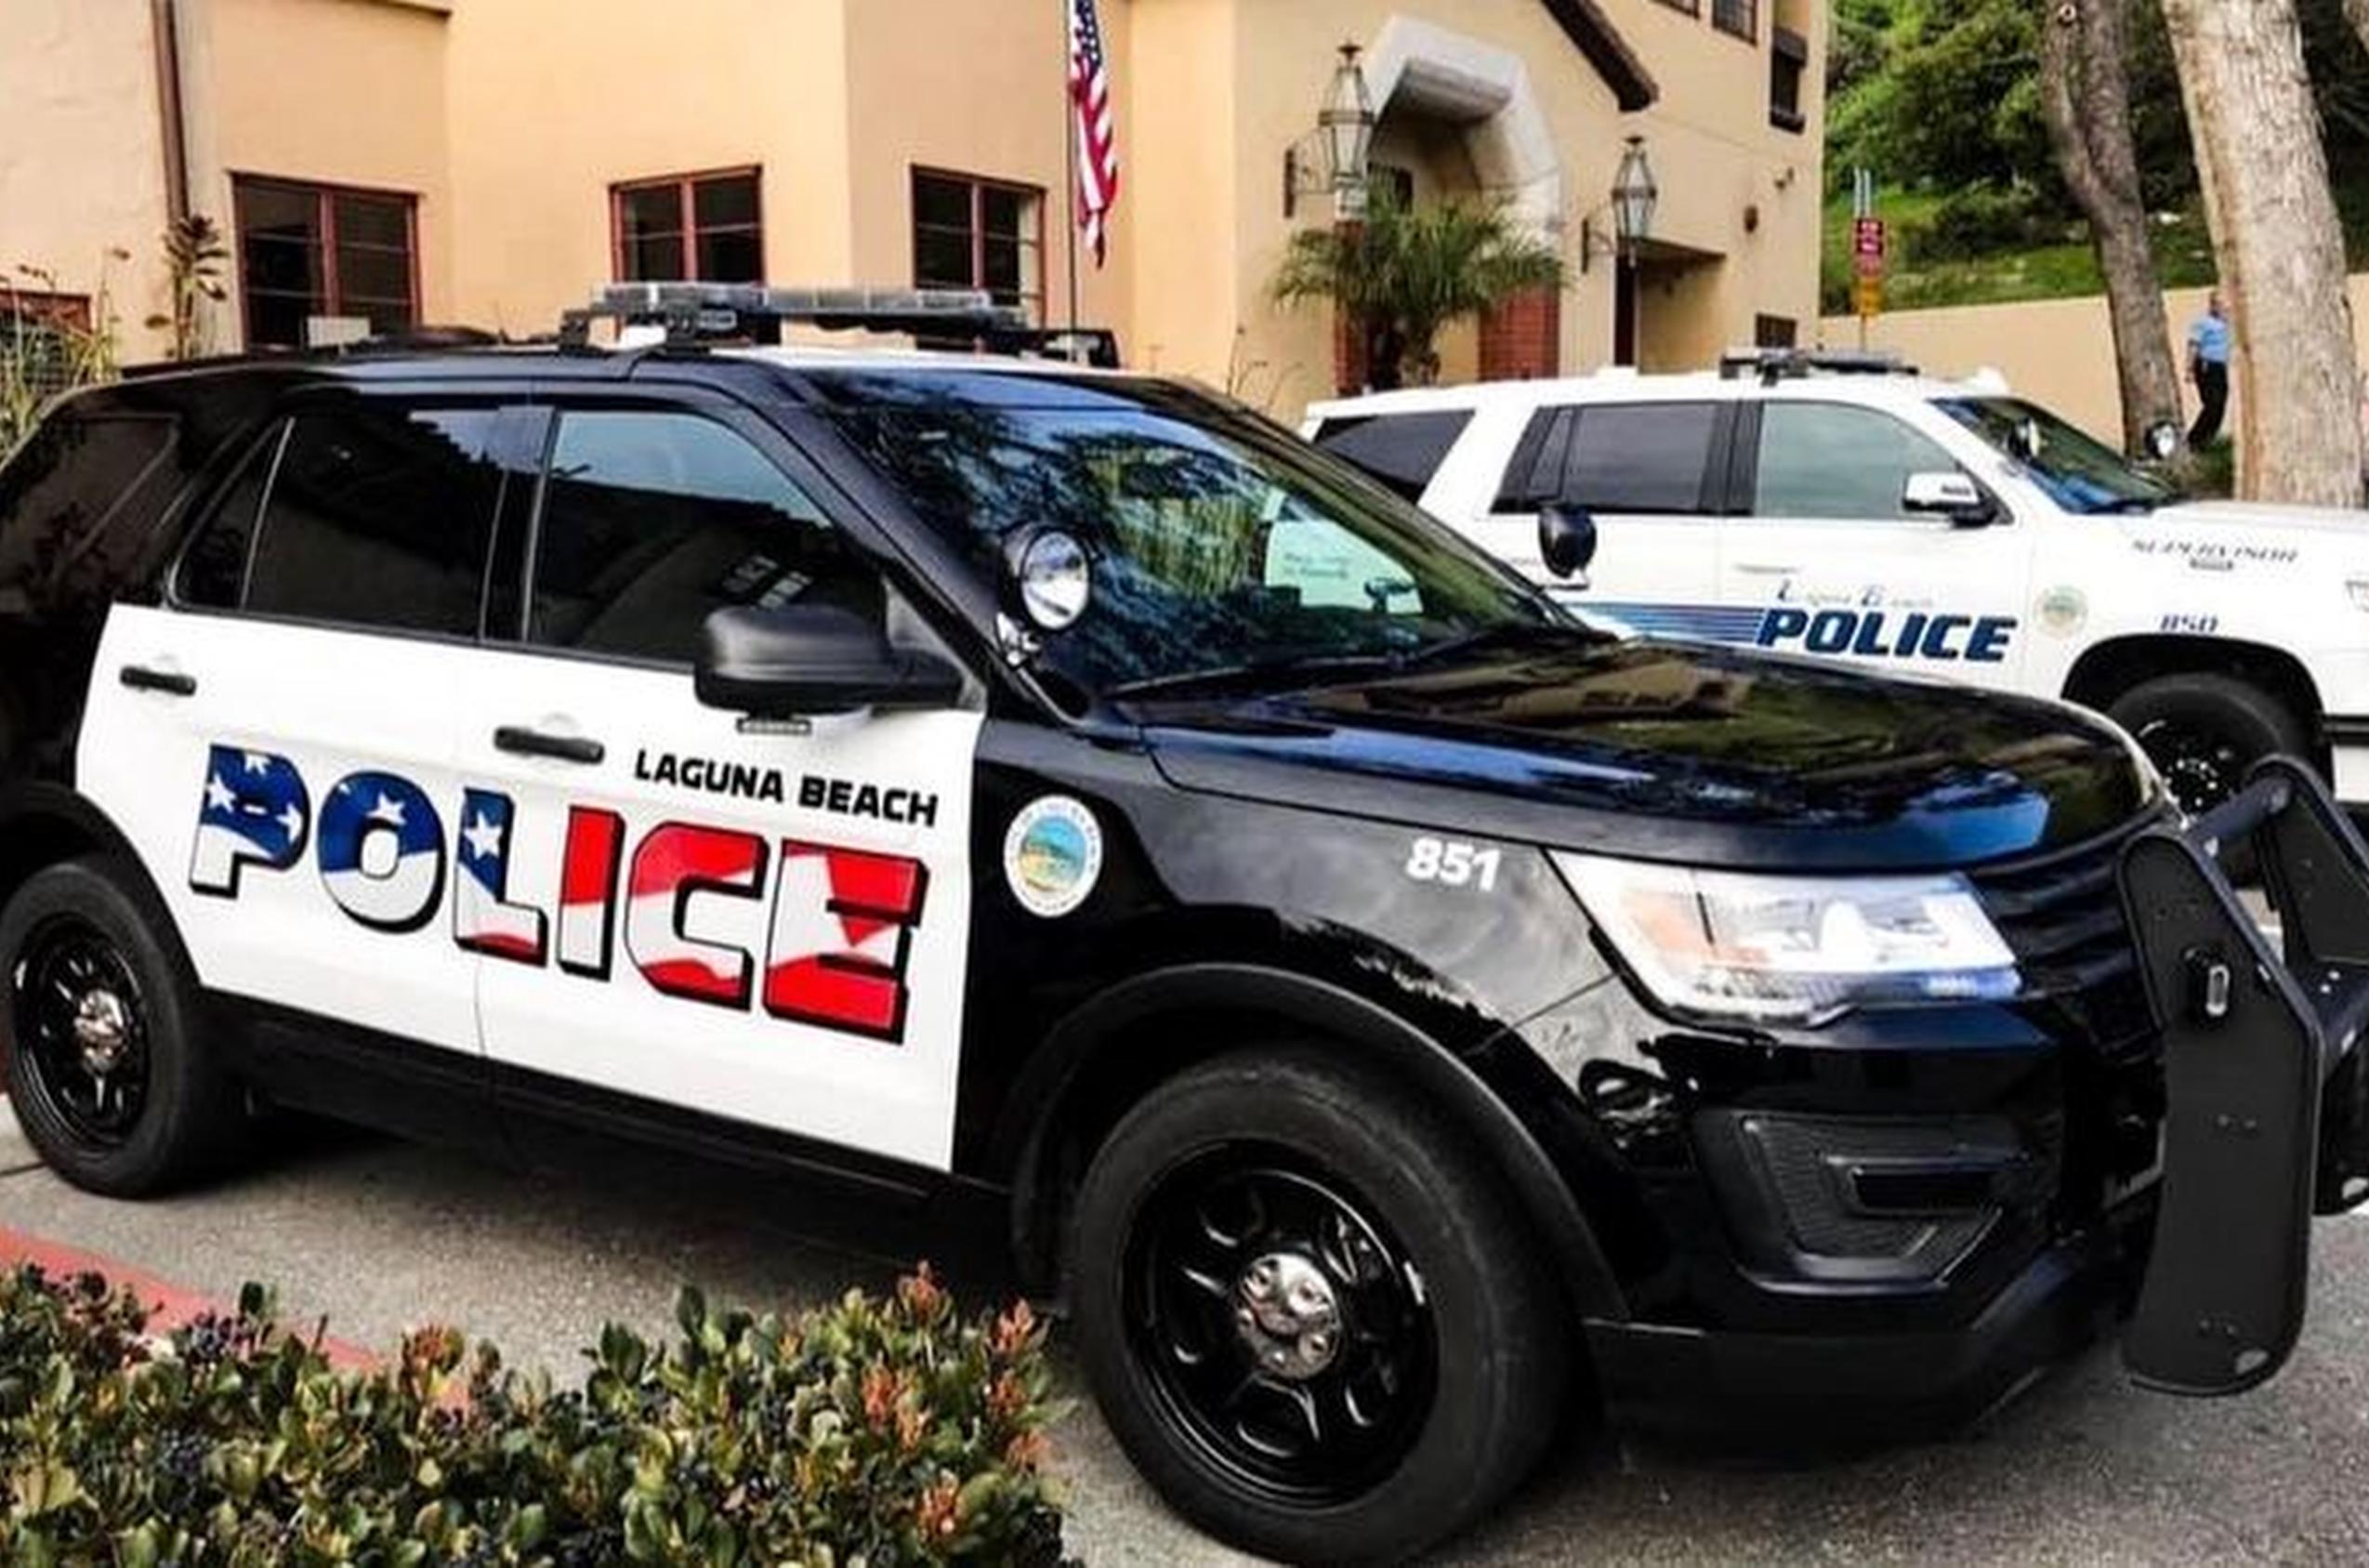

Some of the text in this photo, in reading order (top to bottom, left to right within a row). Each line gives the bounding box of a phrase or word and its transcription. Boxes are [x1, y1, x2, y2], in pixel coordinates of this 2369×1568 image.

[1756, 609, 2018, 661] POLICE
[635, 749, 940, 827] LAGUNA BEACH
[189, 744, 928, 1045] POLICE
[1406, 837, 1501, 891] 851
